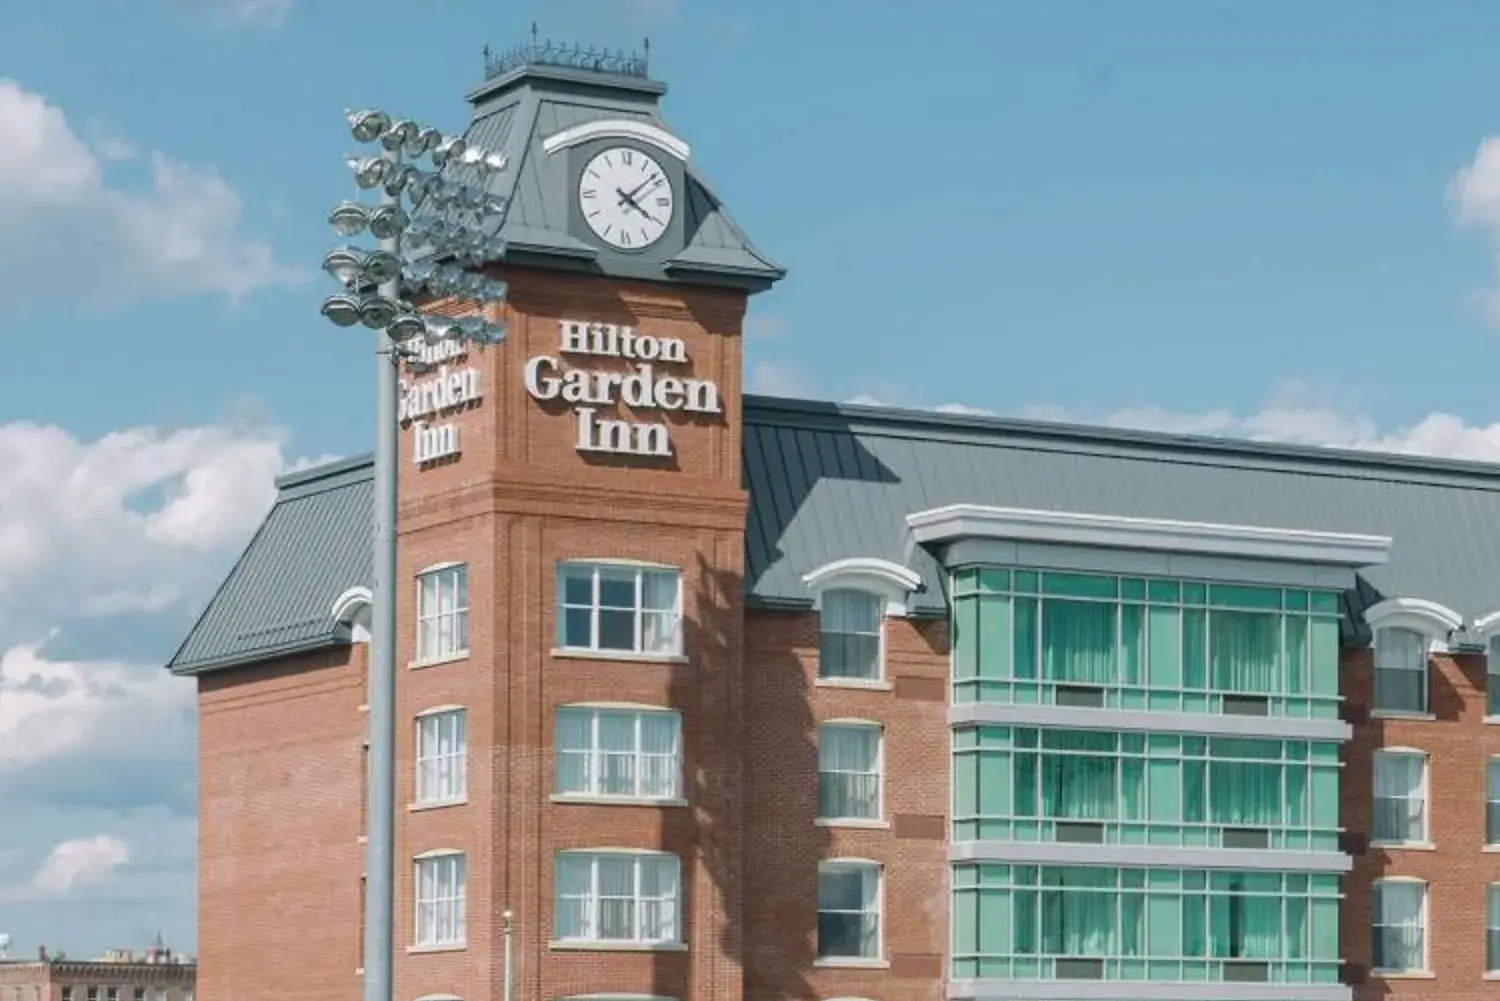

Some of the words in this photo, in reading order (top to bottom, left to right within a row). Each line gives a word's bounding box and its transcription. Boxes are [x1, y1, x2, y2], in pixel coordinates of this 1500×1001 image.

[559, 319, 688, 363] Hilton
[524, 355, 721, 413] Garden
[413, 420, 461, 464] Inn
[575, 407, 673, 456] Inn
